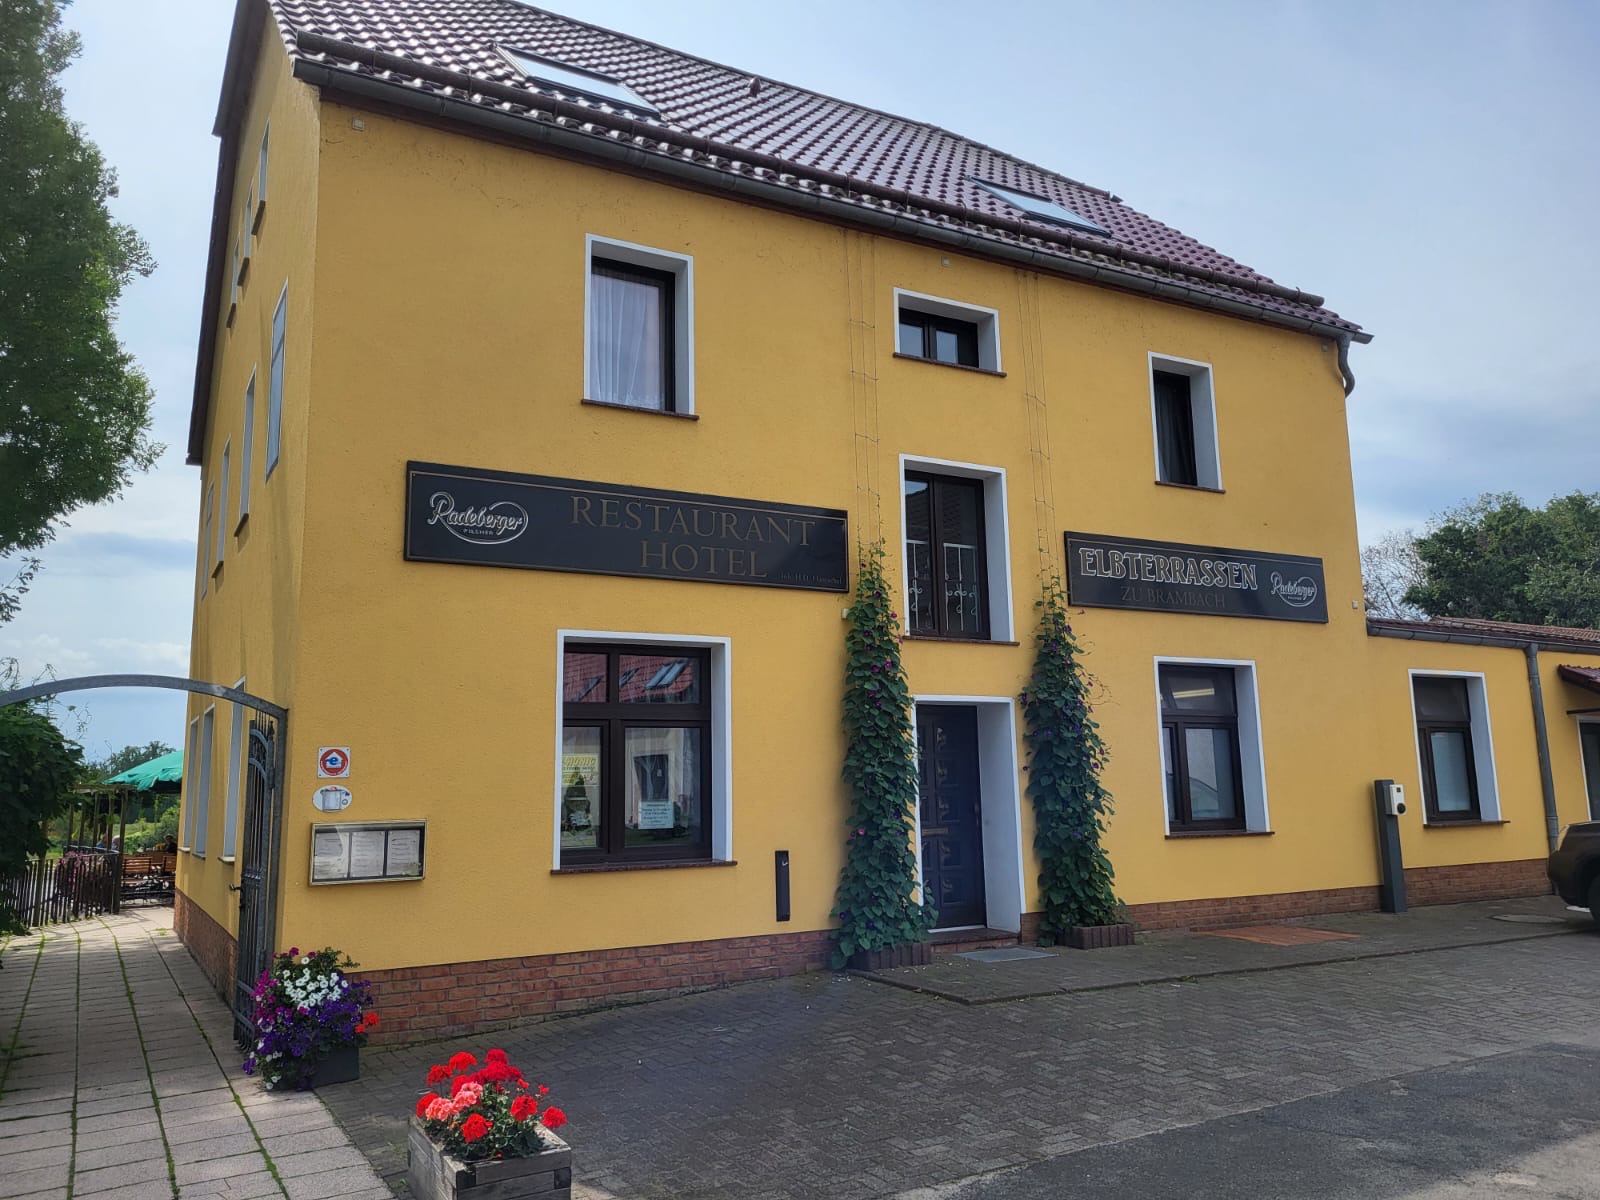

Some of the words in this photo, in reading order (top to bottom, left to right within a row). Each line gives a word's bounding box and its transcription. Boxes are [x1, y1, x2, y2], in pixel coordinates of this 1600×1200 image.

[427, 491, 527, 539] Radeberger
[571, 494, 815, 546] RESTAURANT
[641, 539, 767, 578] HOTEL
[1078, 547, 1257, 591] ELBTERRASSEN
[1120, 586, 1143, 602] ZU
[1148, 587, 1225, 608] BRAMBACH
[1270, 571, 1316, 602] Radeberger
